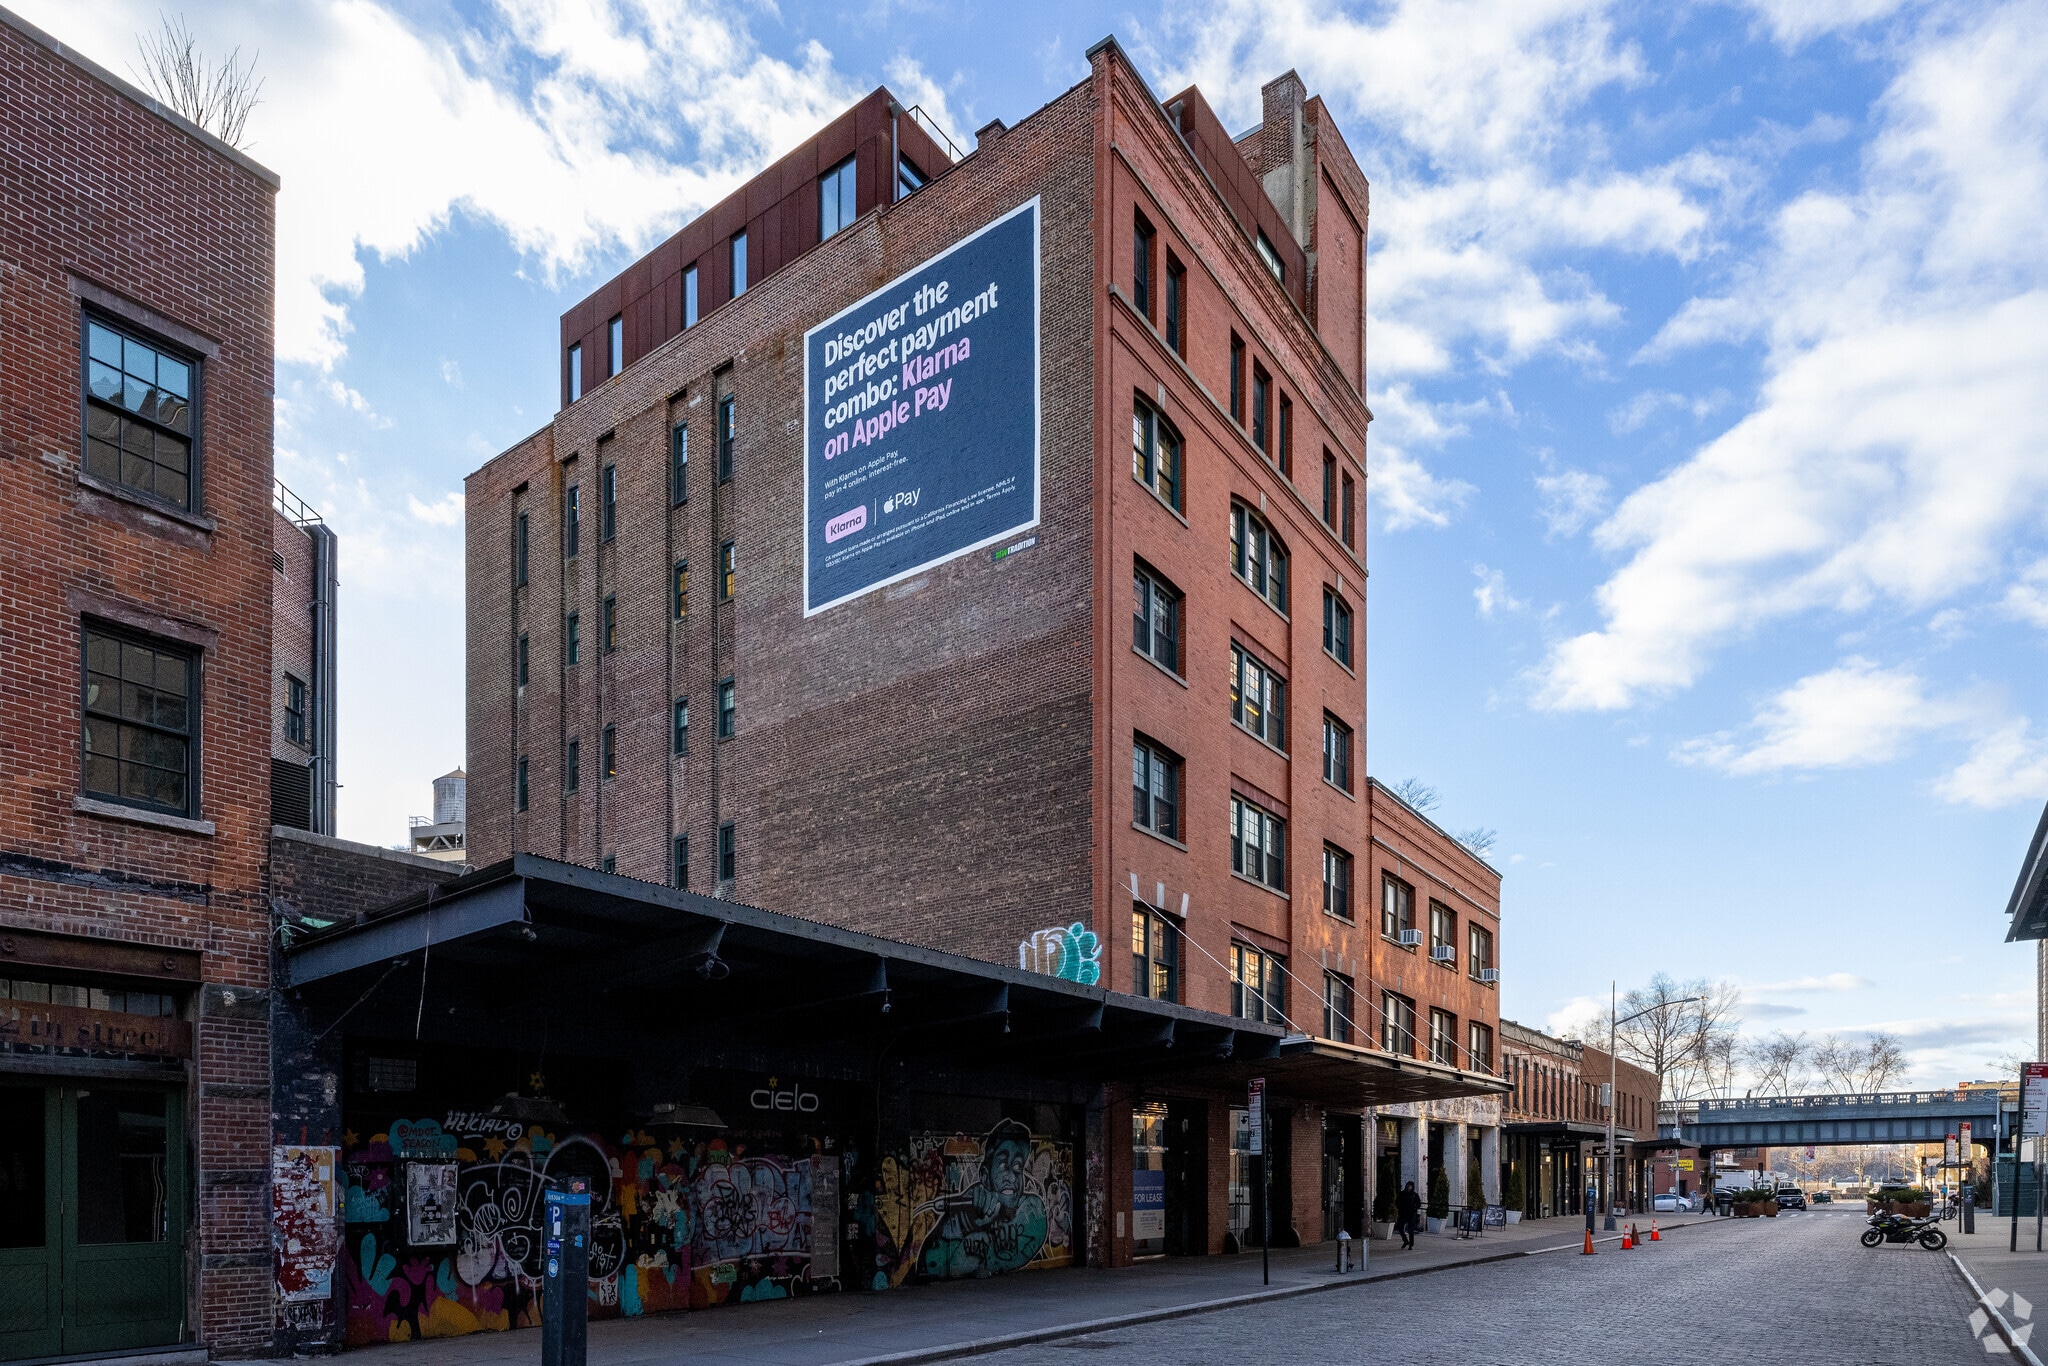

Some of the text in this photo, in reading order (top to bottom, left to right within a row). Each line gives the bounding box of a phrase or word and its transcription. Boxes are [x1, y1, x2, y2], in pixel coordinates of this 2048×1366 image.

[824, 280, 949, 368] Discover the
[824, 281, 998, 405] perfect payment
[824, 337, 970, 429] combo: Klarna
[824, 377, 953, 461] on Apple Pay
[824, 477, 838, 489] With
[838, 468, 858, 482] Klarna
[858, 464, 867, 474] on
[867, 456, 886, 469] Apple
[824, 490, 835, 501] pay
[836, 486, 842, 494] in
[842, 482, 847, 490] 4
[895, 487, 921, 510] Pay
[830, 515, 862, 537] Klarna
[750, 1082, 819, 1112] cielo
[1134, 1192, 1163, 1203] FOR LEASE
[552, 1206, 561, 1224] P
